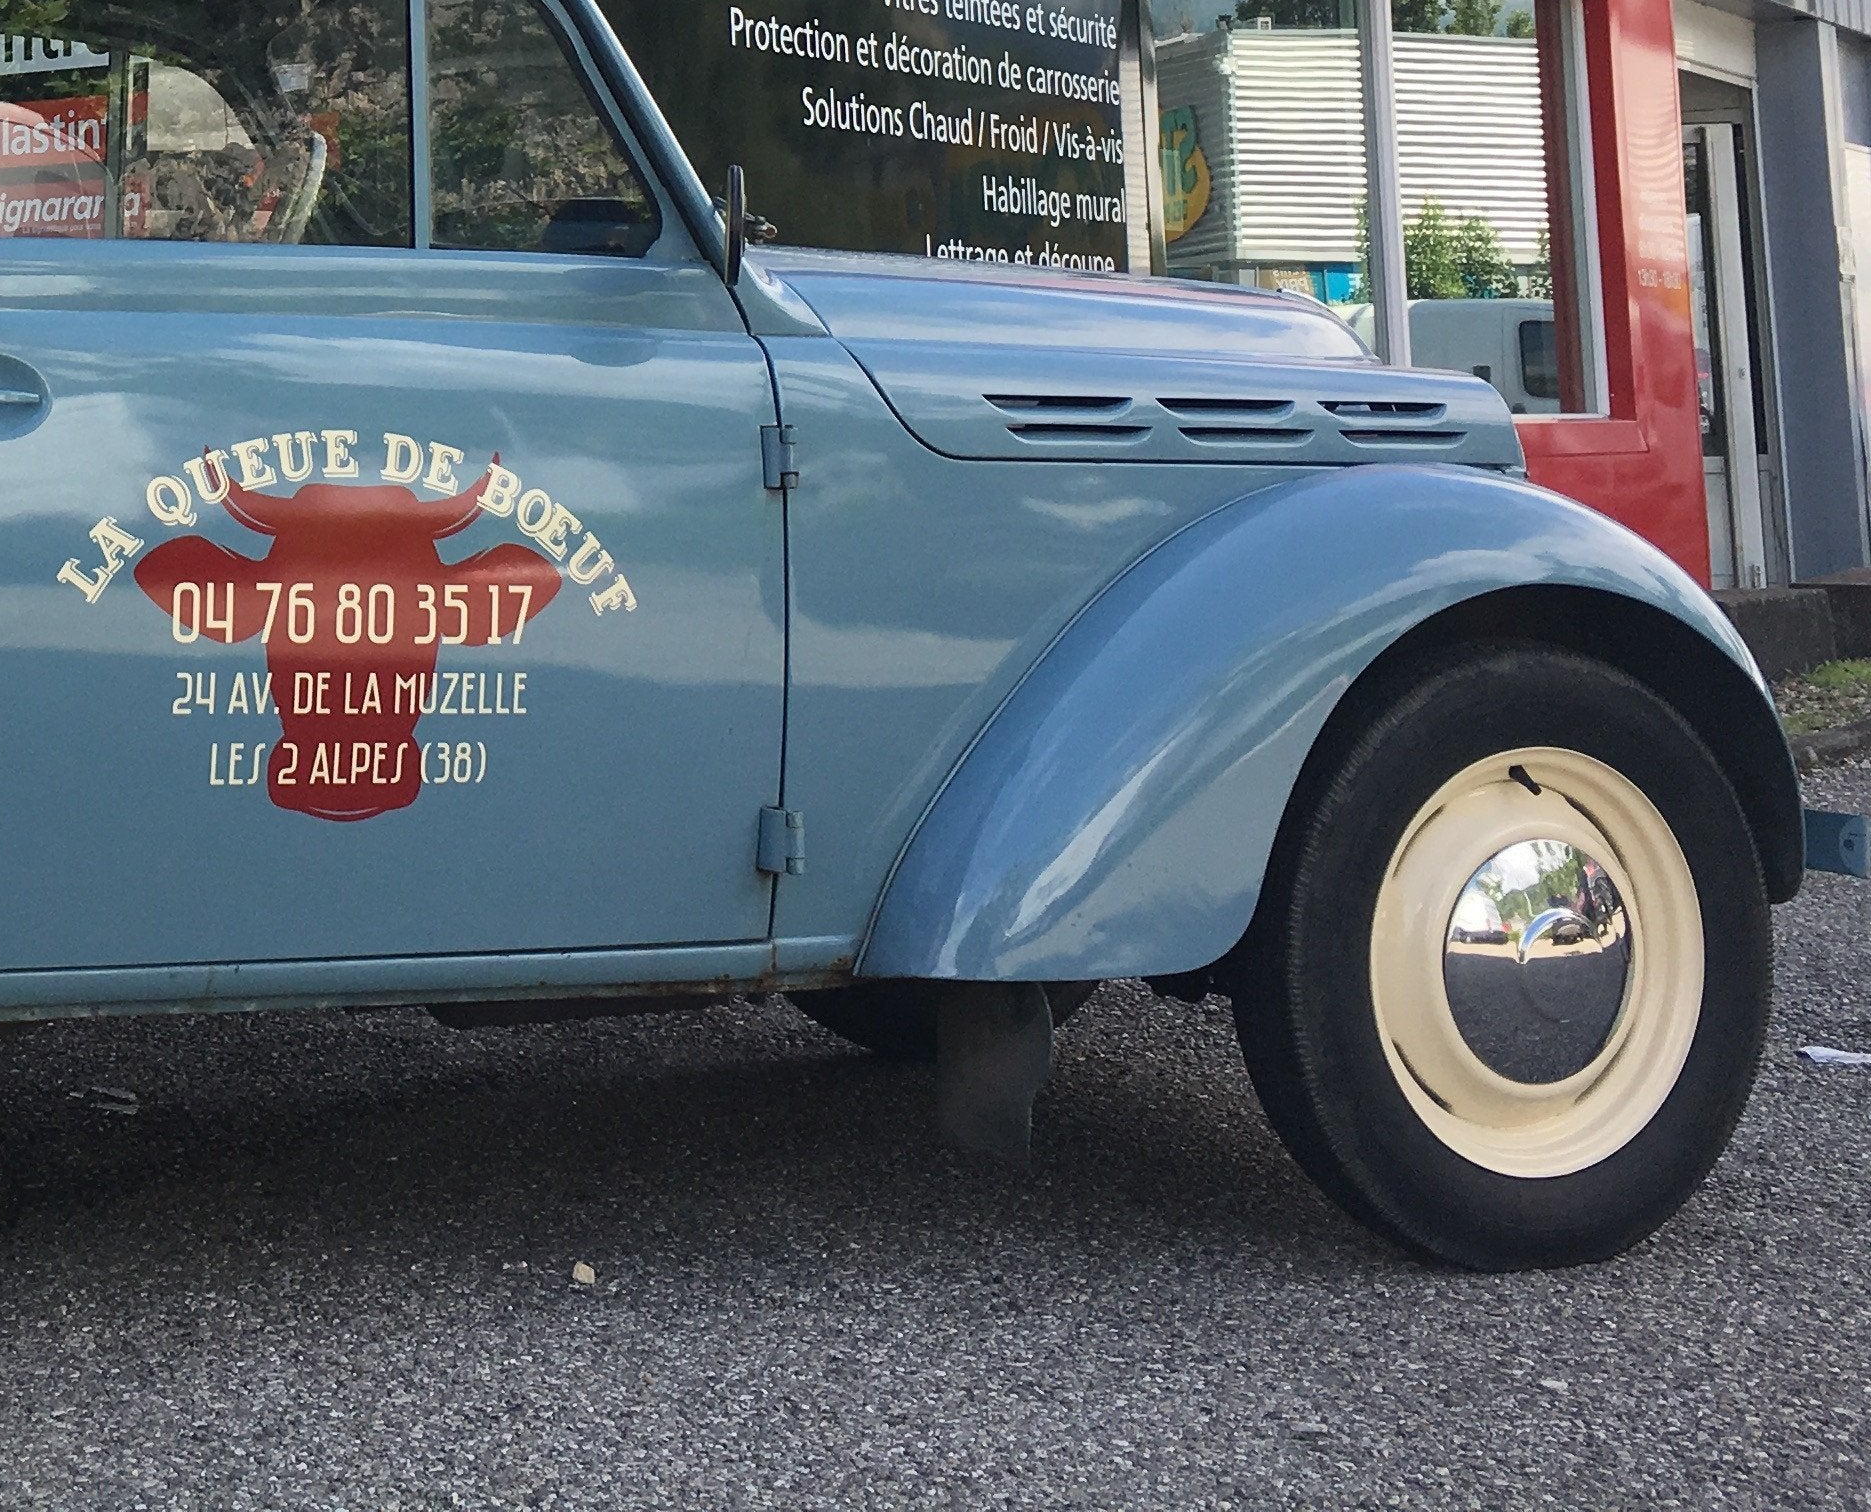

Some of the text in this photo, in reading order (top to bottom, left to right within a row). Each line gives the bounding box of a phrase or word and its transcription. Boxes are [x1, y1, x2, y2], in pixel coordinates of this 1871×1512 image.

[730, 6, 1120, 106] Protection et décoration de carrosserie
[1026, 4, 1045, 35] et
[1049, 6, 1118, 50] sécurité
[802, 86, 904, 138] Solutions
[909, 100, 973, 148] Chaud
[990, 113, 1039, 155] Froid
[1052, 122, 1124, 165] Vis-à-vis
[982, 175, 1126, 228] Habillage mural
[56, 516, 145, 604] LA
[146, 429, 360, 528] QUEUE
[380, 432, 466, 497] DE
[171, 582, 533, 646] 04 76 80 35 17
[171, 672, 528, 716] 24 AV. DE LA MUZELLE
[209, 741, 488, 787] LES 2 ALPES (38)
